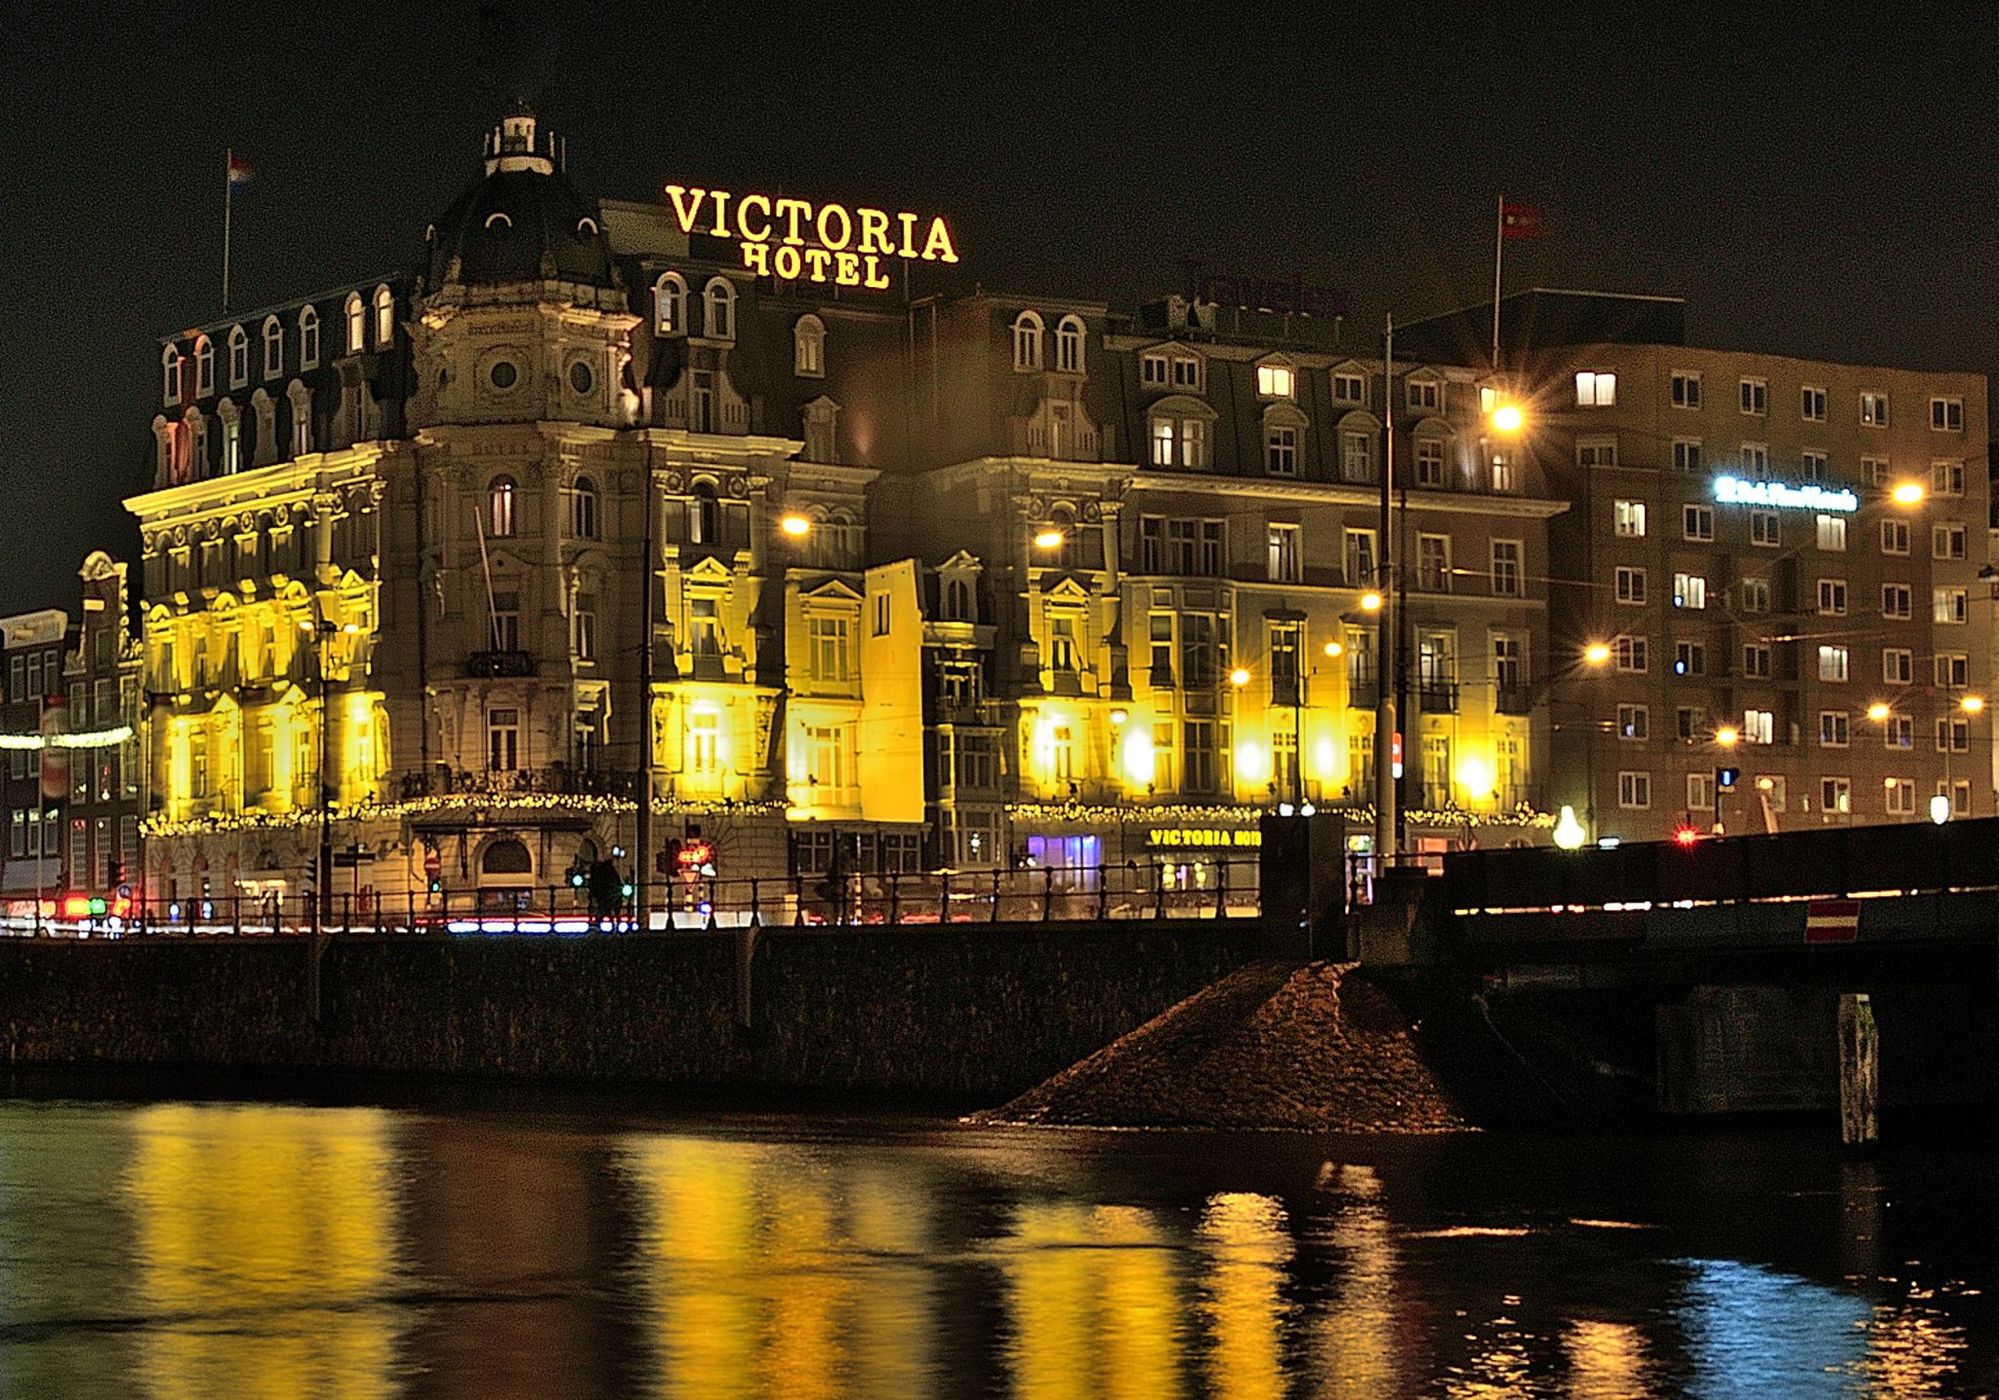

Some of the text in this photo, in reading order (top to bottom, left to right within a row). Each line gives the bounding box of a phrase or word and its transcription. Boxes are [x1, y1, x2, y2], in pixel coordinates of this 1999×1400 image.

[665, 185, 959, 263] VICTORIA
[740, 242, 890, 290] HOTEL
[1150, 829, 1231, 846] VICTORIA
